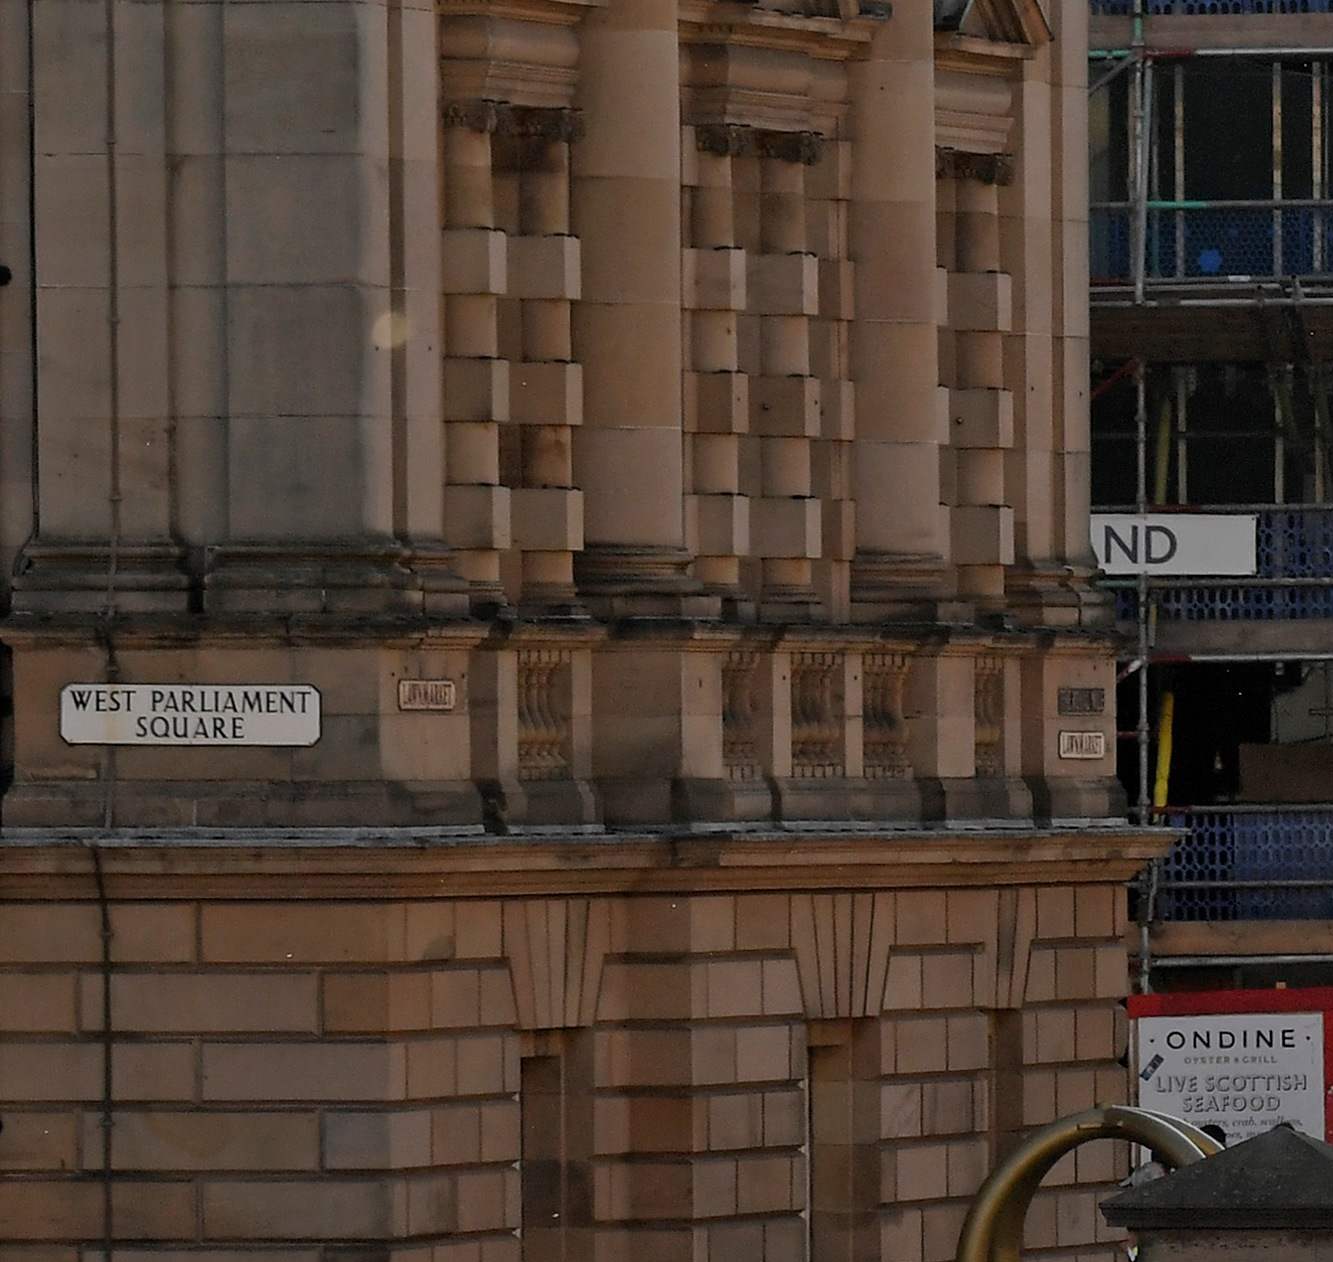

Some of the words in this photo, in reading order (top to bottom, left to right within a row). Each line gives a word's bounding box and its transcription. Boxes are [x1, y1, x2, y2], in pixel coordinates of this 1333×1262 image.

[71, 689, 137, 713] WEST
[151, 689, 311, 714] PARLIAMENT
[136, 716, 245, 740] SQUARE
[1166, 1029, 1296, 1050] ONDINE
[1184, 1055, 1230, 1064] OYSTER
[1242, 1055, 1277, 1063] GRILL
[1156, 1075, 1198, 1092] LIVE
[1205, 1073, 1307, 1092] SCOTTISH
[1183, 1096, 1282, 1113] SEAFOOD
